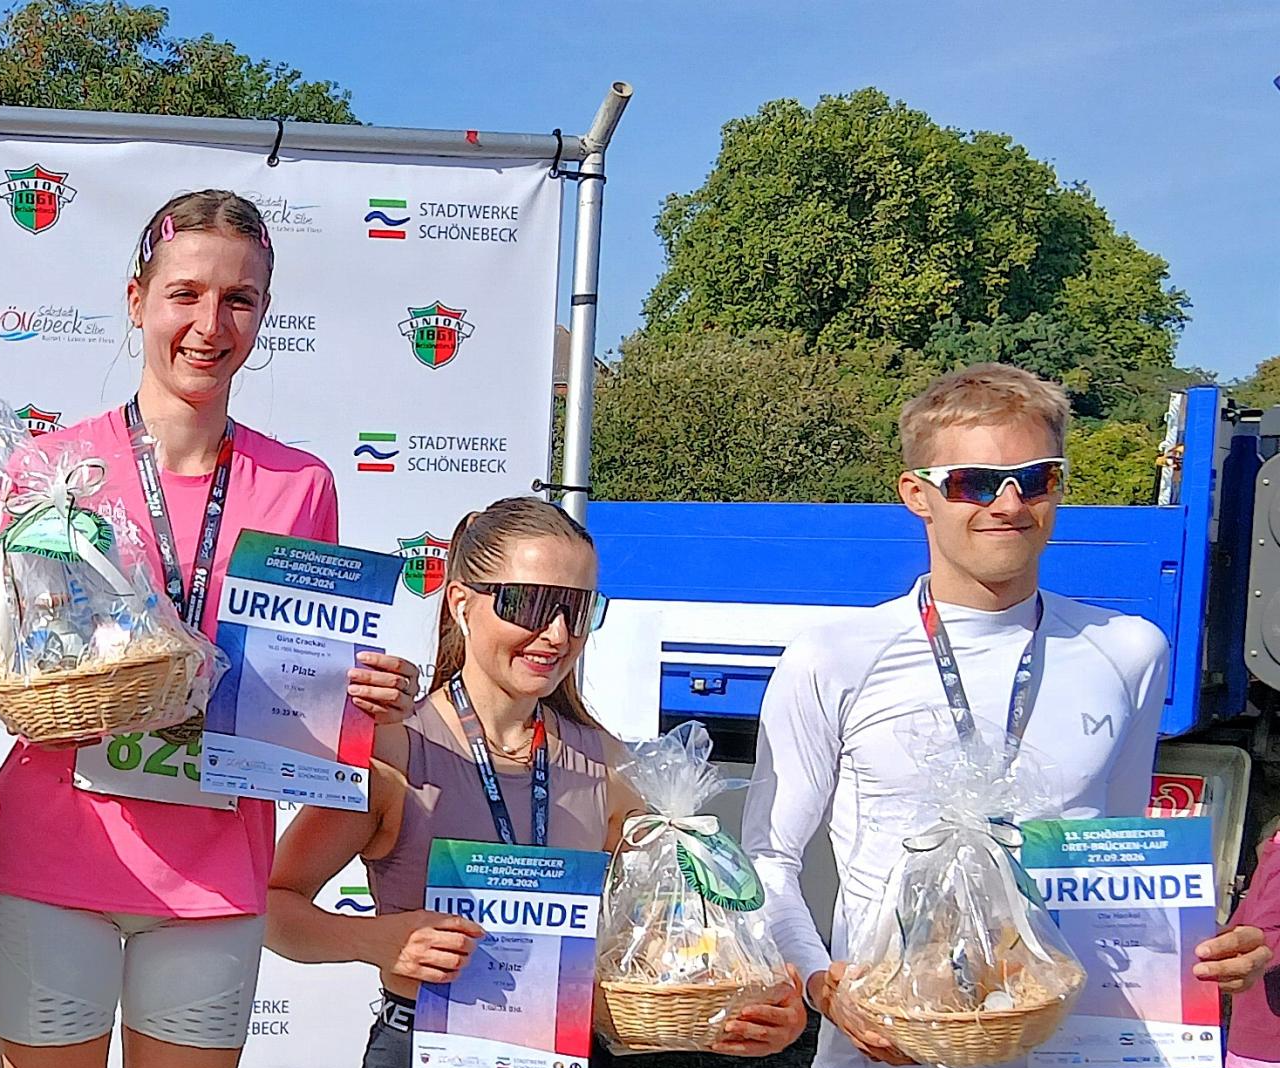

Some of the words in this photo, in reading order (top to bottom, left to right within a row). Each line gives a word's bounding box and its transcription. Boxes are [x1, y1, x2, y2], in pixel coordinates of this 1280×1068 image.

[7, 180, 65, 195] UNION
[419, 202, 519, 220] STADTWERKE
[418, 223, 519, 243] SCHÖNEBECK
[264, 314, 316, 330] WERKE
[409, 316, 464, 331] UNION
[257, 336, 316, 352] NEBECK
[408, 435, 508, 452] STADTWERKE
[407, 454, 507, 474] SCHÖNEBECK
[228, 587, 381, 639] URKUNDE
[291, 664, 317, 678] Platz
[465, 864, 565, 879] DREI-BRÜCKEN-LAUF
[499, 962, 523, 972] Platz
